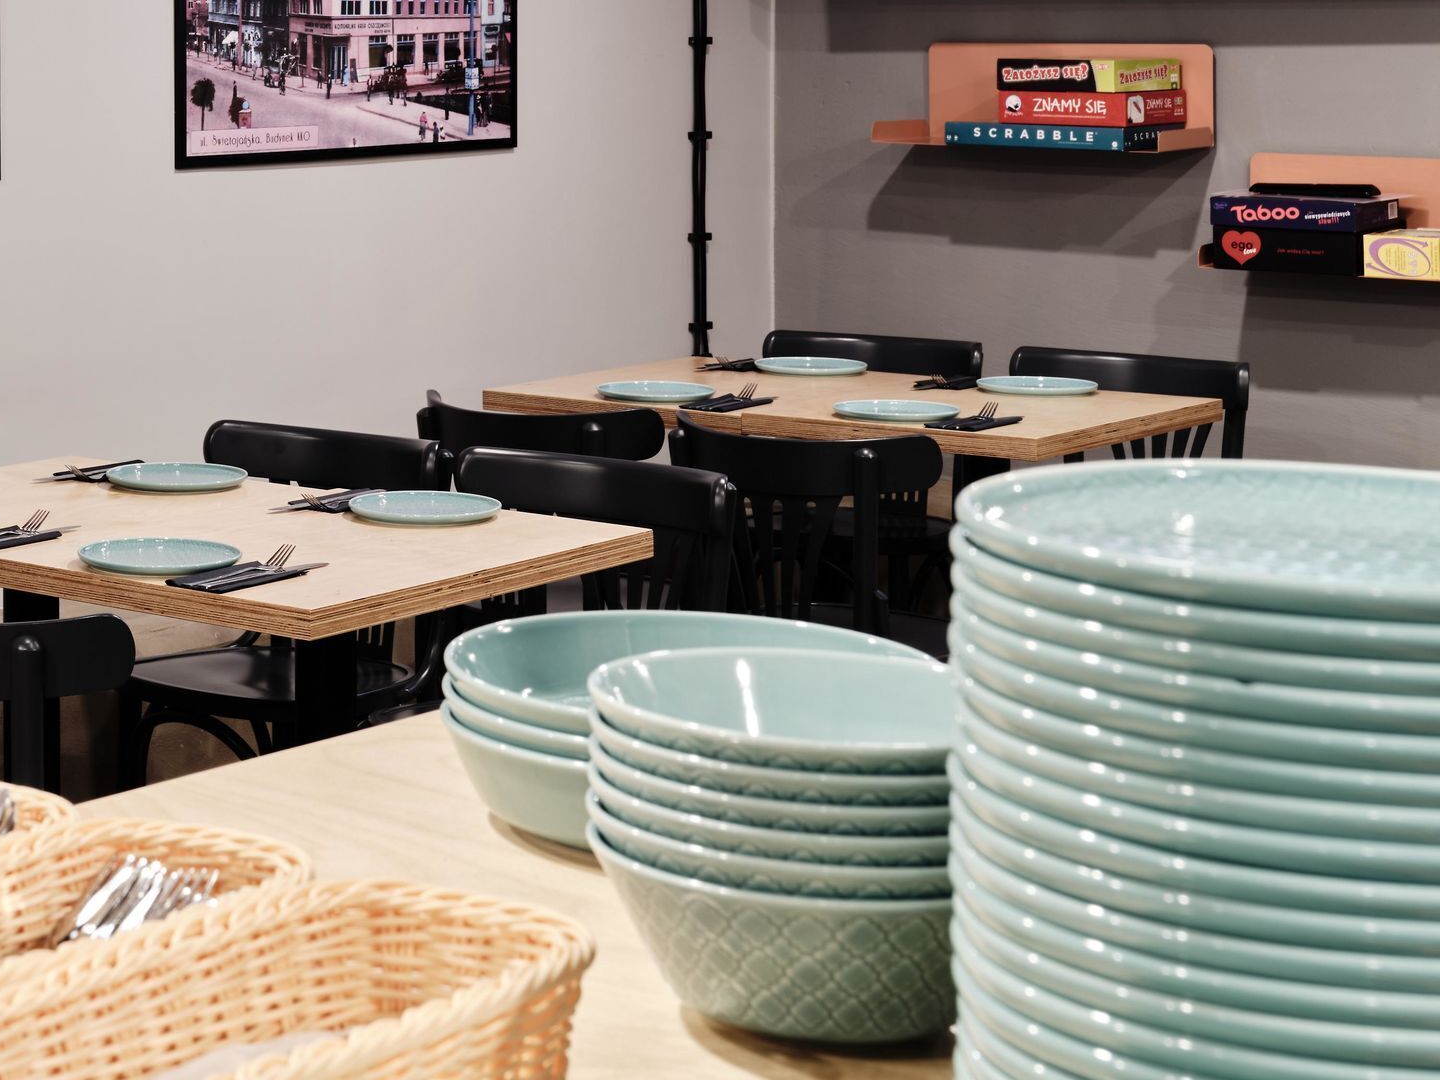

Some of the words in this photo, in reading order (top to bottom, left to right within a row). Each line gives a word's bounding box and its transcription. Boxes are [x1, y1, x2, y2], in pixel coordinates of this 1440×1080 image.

[1032, 97, 1081, 114] ZNAMY
[1085, 99, 1108, 116] SIĘ
[972, 126, 1095, 143] SCRABBLE
[1230, 204, 1300, 224] Taboo
[1231, 241, 1254, 252] ego
